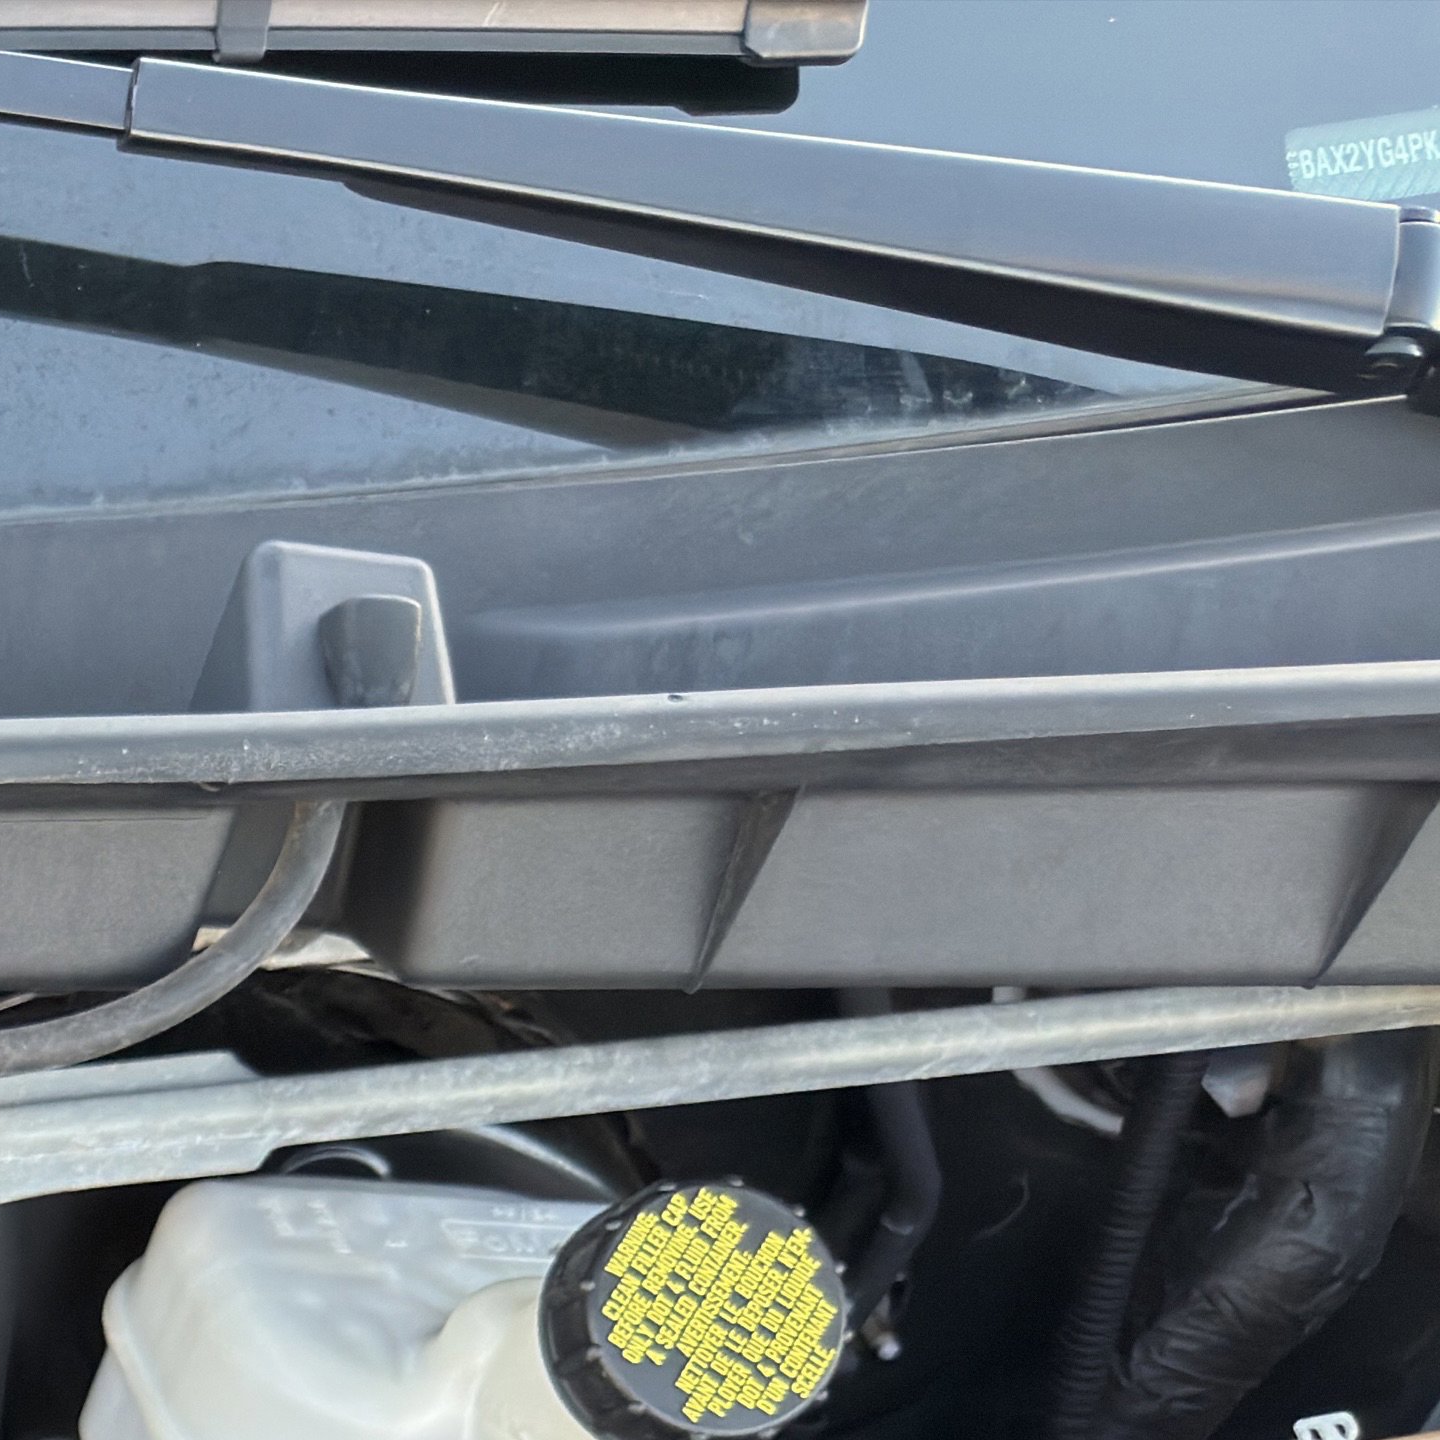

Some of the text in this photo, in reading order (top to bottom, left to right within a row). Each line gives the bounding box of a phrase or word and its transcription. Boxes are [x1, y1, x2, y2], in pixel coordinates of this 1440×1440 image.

[602, 1193, 688, 1321] CLEAN FILLER CAP
[606, 1213, 659, 1278] WARNING:
[608, 1189, 717, 1349] BEFORE REMOVING. USE
[622, 1194, 738, 1364] ONLY DOT 4 FLUID FROM
[646, 1219, 747, 1366] A SEALED CONTAINER.
[676, 1250, 754, 1357] AVERTISSEMENT:
[676, 1231, 786, 1394] NETTOYER LE BOUCHON
[683, 1373, 720, 1422] AVANT
[710, 1352, 734, 1377] DE
[723, 1330, 748, 1354] LE
[707, 1253, 820, 1416] PLOYER QUE DU LIQUIDE
[736, 1283, 823, 1409] DOT 4 PROVENANT
[756, 1299, 837, 1415] D'UN CONTENANT
